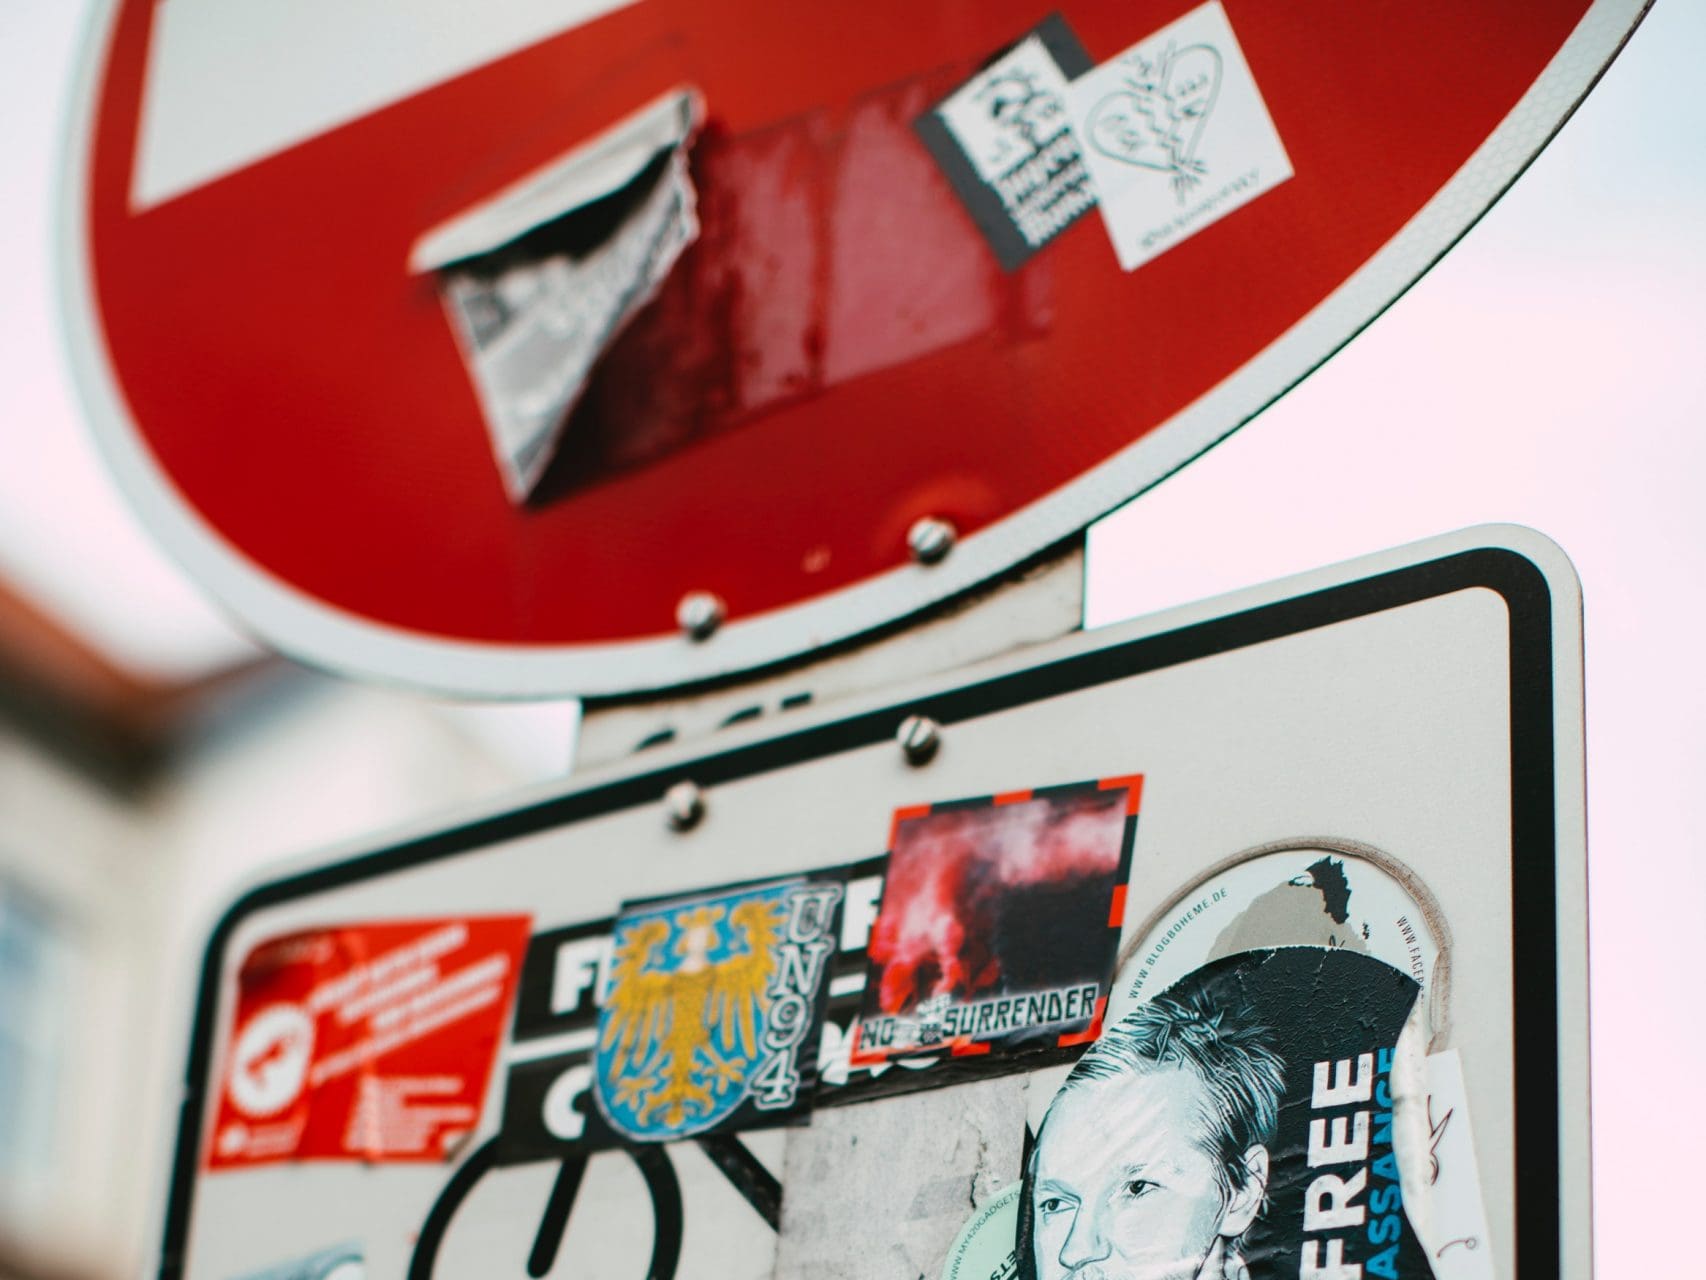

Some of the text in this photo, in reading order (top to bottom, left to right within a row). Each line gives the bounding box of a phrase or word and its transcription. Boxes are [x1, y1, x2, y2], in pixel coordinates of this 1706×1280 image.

[1128, 887, 1229, 1000] WWW.BLOGBOHEME.DE
[860, 986, 1098, 1049] NO SURRENDER
